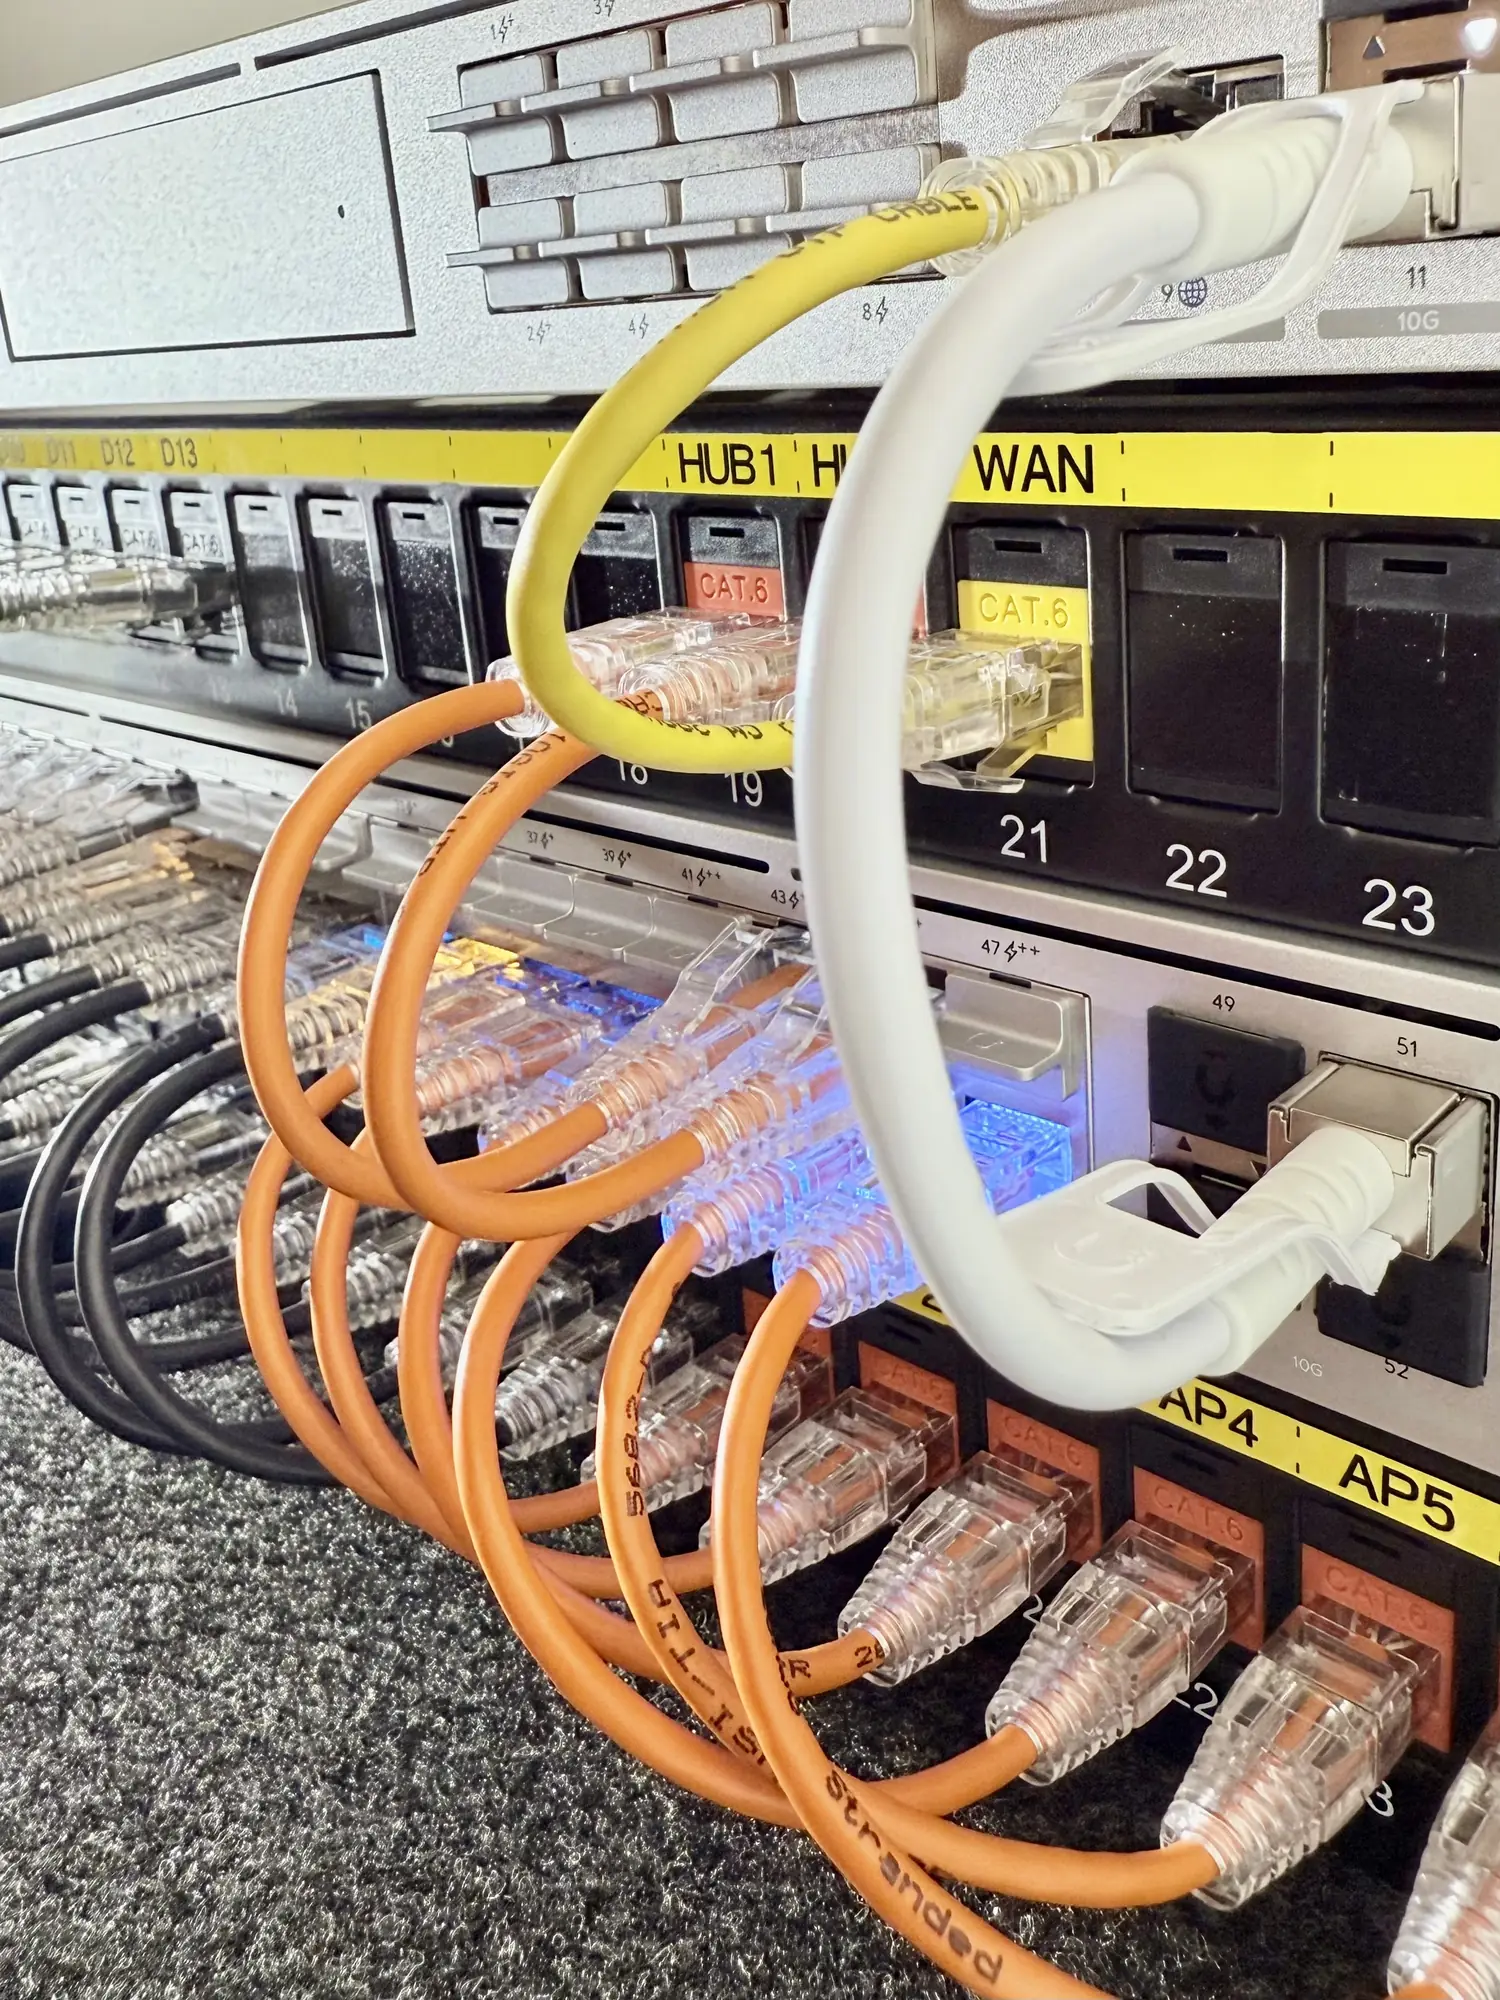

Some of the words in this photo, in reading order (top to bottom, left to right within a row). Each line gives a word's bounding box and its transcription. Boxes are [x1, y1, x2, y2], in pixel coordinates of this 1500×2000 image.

[1161, 284, 1174, 303] 9
[1405, 265, 1427, 290] 11
[863, 303, 871, 320] 8
[1397, 310, 1440, 332] 10G
[101, 438, 136, 466] D12
[160, 437, 198, 469] D13
[678, 442, 775, 486] HUB1
[972, 444, 1094, 494] WAN
[700, 572, 769, 604] CAT.6
[978, 592, 1070, 629] CAT.6
[273, 688, 298, 718] 14
[345, 697, 372, 730] 15
[724, 771, 763, 807] 19
[1000, 814, 1047, 864] 21
[1165, 843, 1228, 898] 22
[1361, 878, 1436, 937] 23
[1212, 994, 1236, 1013] 49
[1396, 1036, 1418, 1058] 51
[1293, 1355, 1323, 1378] 10G
[1158, 1386, 1259, 1449] AP4
[1338, 1453, 1456, 1533] AP5
[1154, 1485, 1244, 1542] CAT.6
[1326, 1564, 1429, 1631] CAT.6
[825, 1769, 1004, 1985] Stranded
